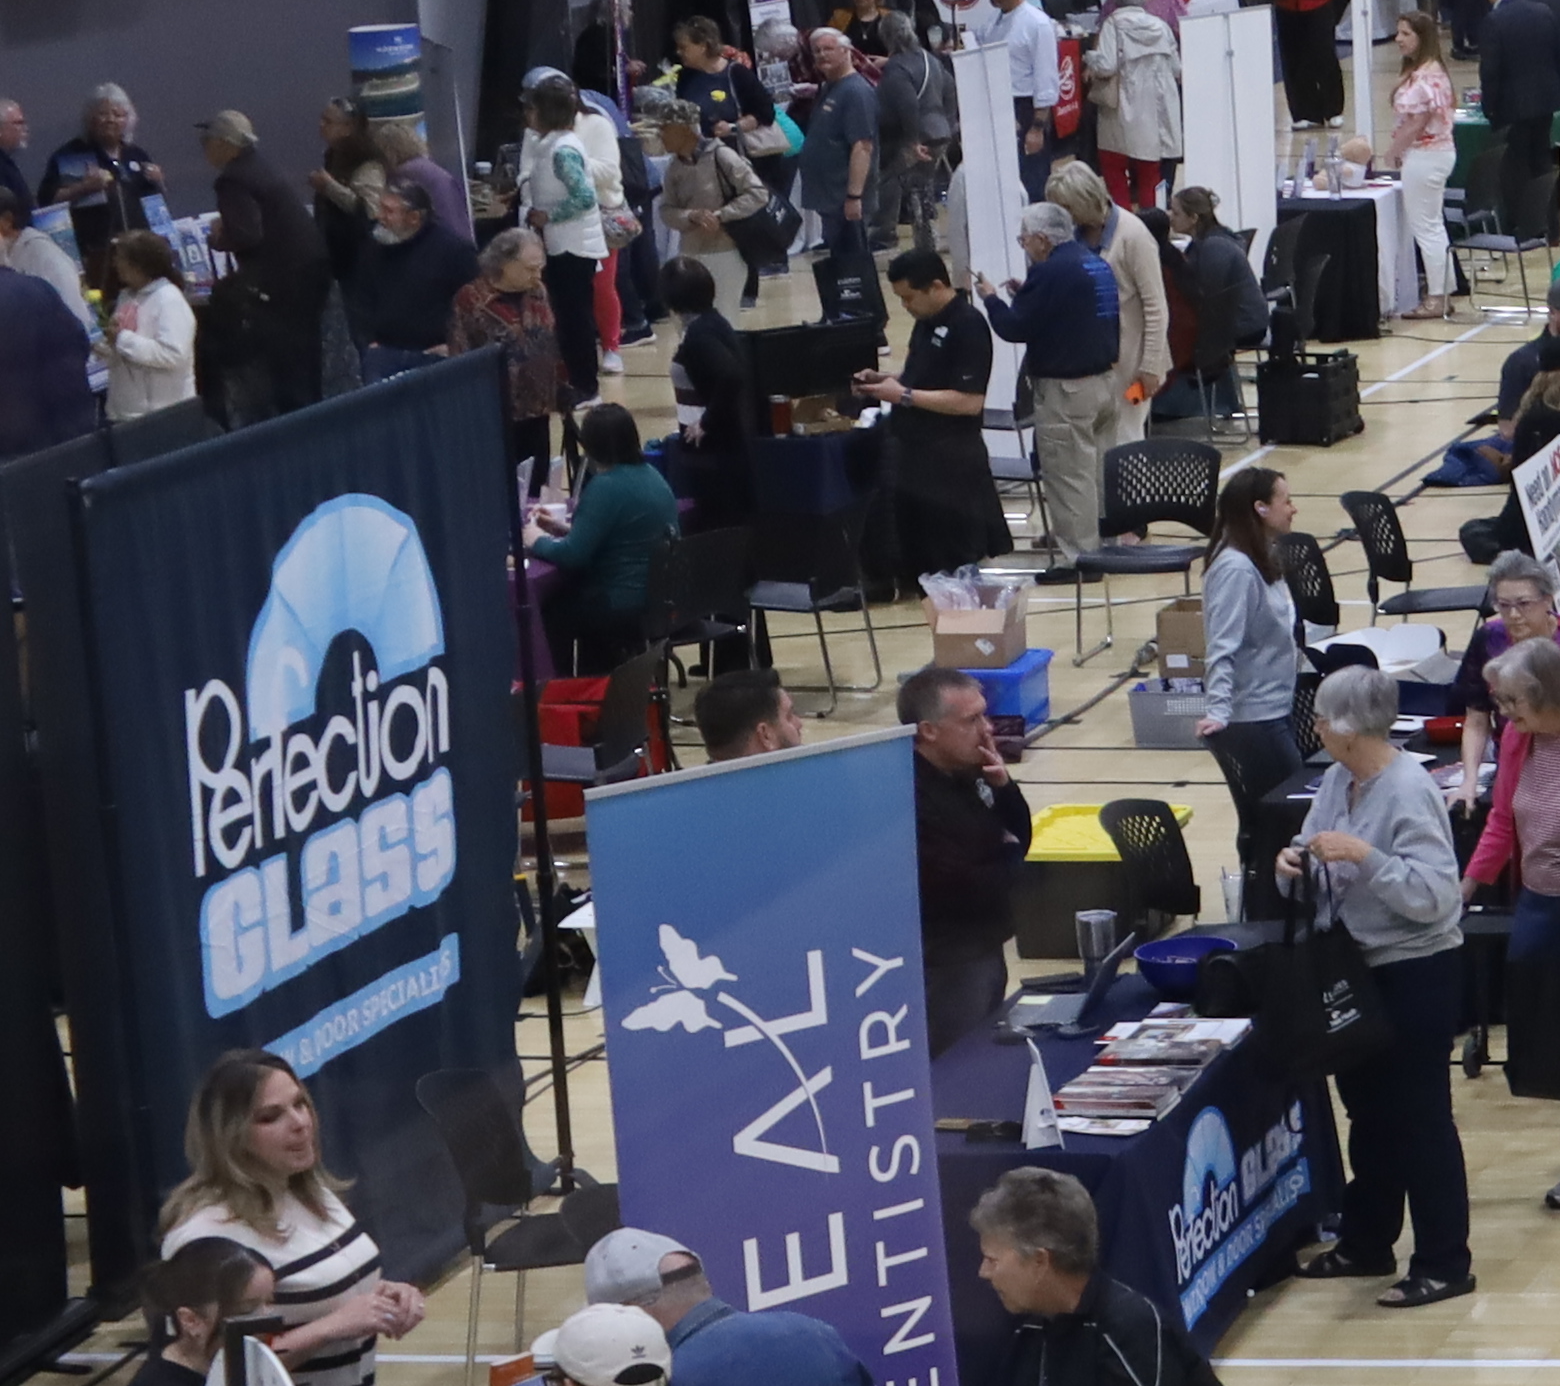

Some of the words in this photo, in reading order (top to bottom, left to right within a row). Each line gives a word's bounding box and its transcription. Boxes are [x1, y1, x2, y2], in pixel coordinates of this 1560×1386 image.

[184, 649, 450, 878] Perfection
[723, 949, 849, 1313] EAL
[1168, 1179, 1240, 1285] Perfection
